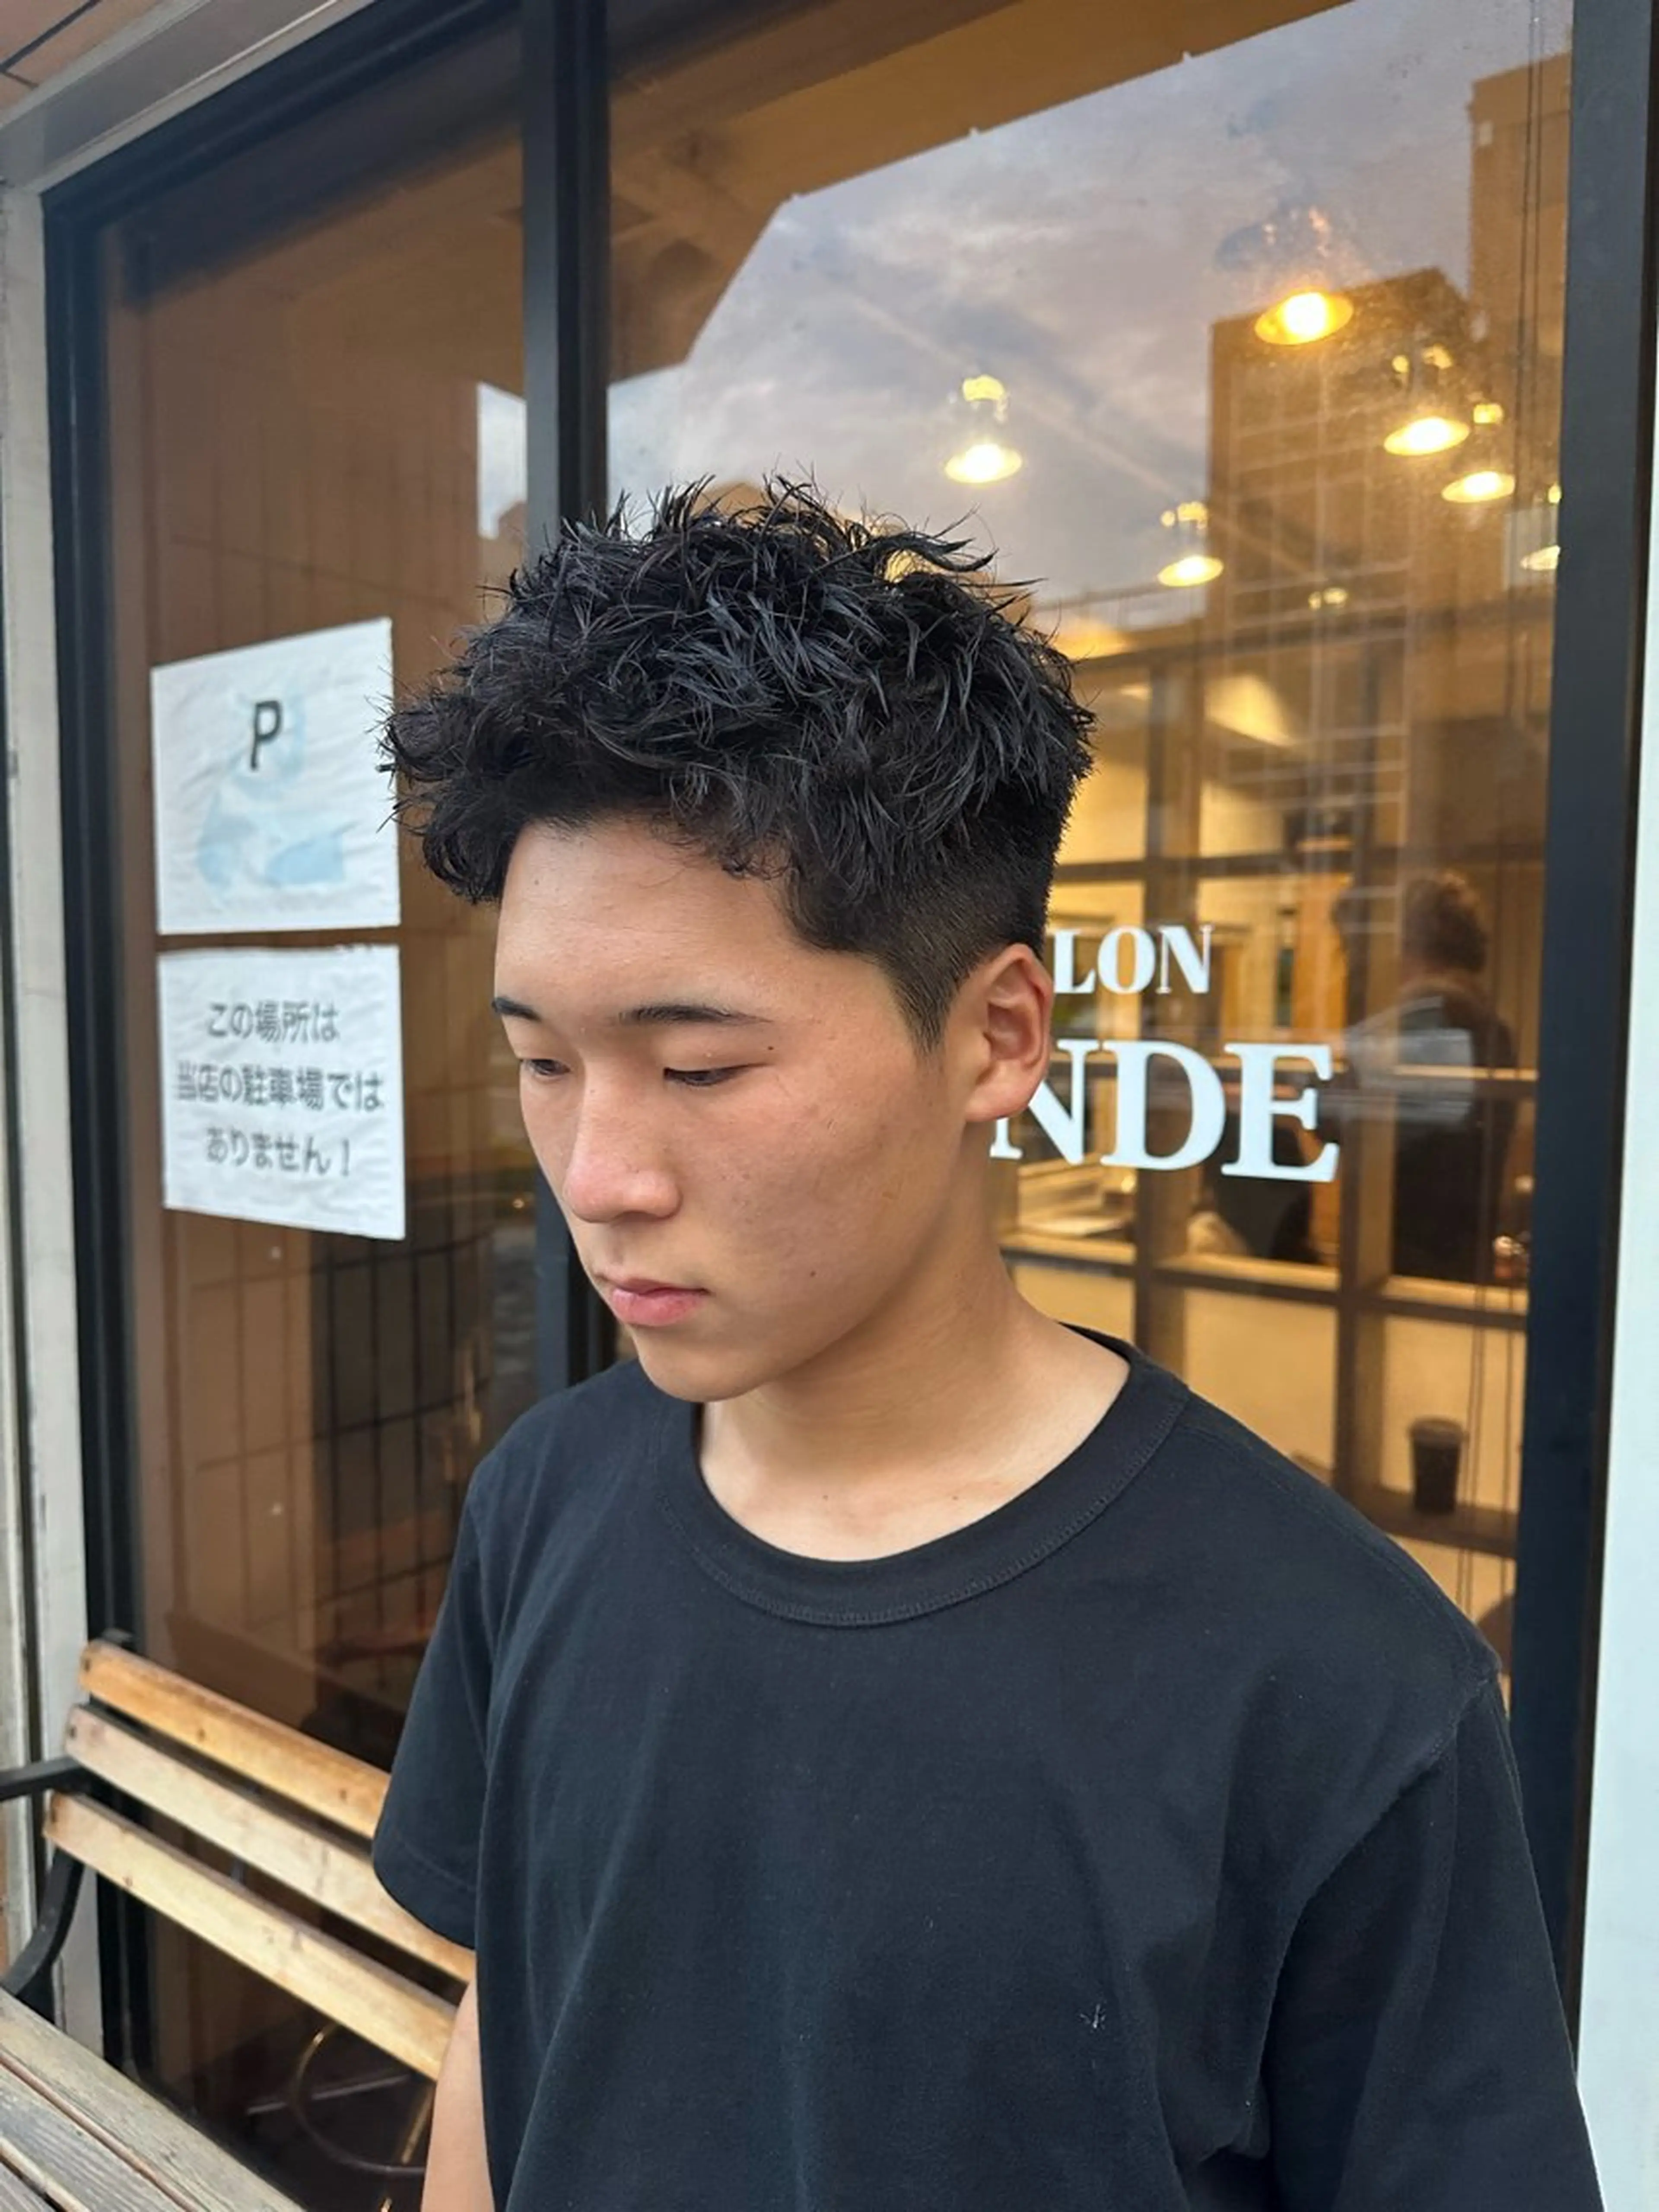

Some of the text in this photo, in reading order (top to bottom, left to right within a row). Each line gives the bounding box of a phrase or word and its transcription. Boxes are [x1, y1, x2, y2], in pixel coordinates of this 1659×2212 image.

[250, 699, 282, 771] P
[1053, 925, 1213, 994] LON
[207, 1001, 340, 1043] この場所は
[176, 1059, 384, 1112] 当店の駐車場では
[989, 1039, 1340, 1182] NDE
